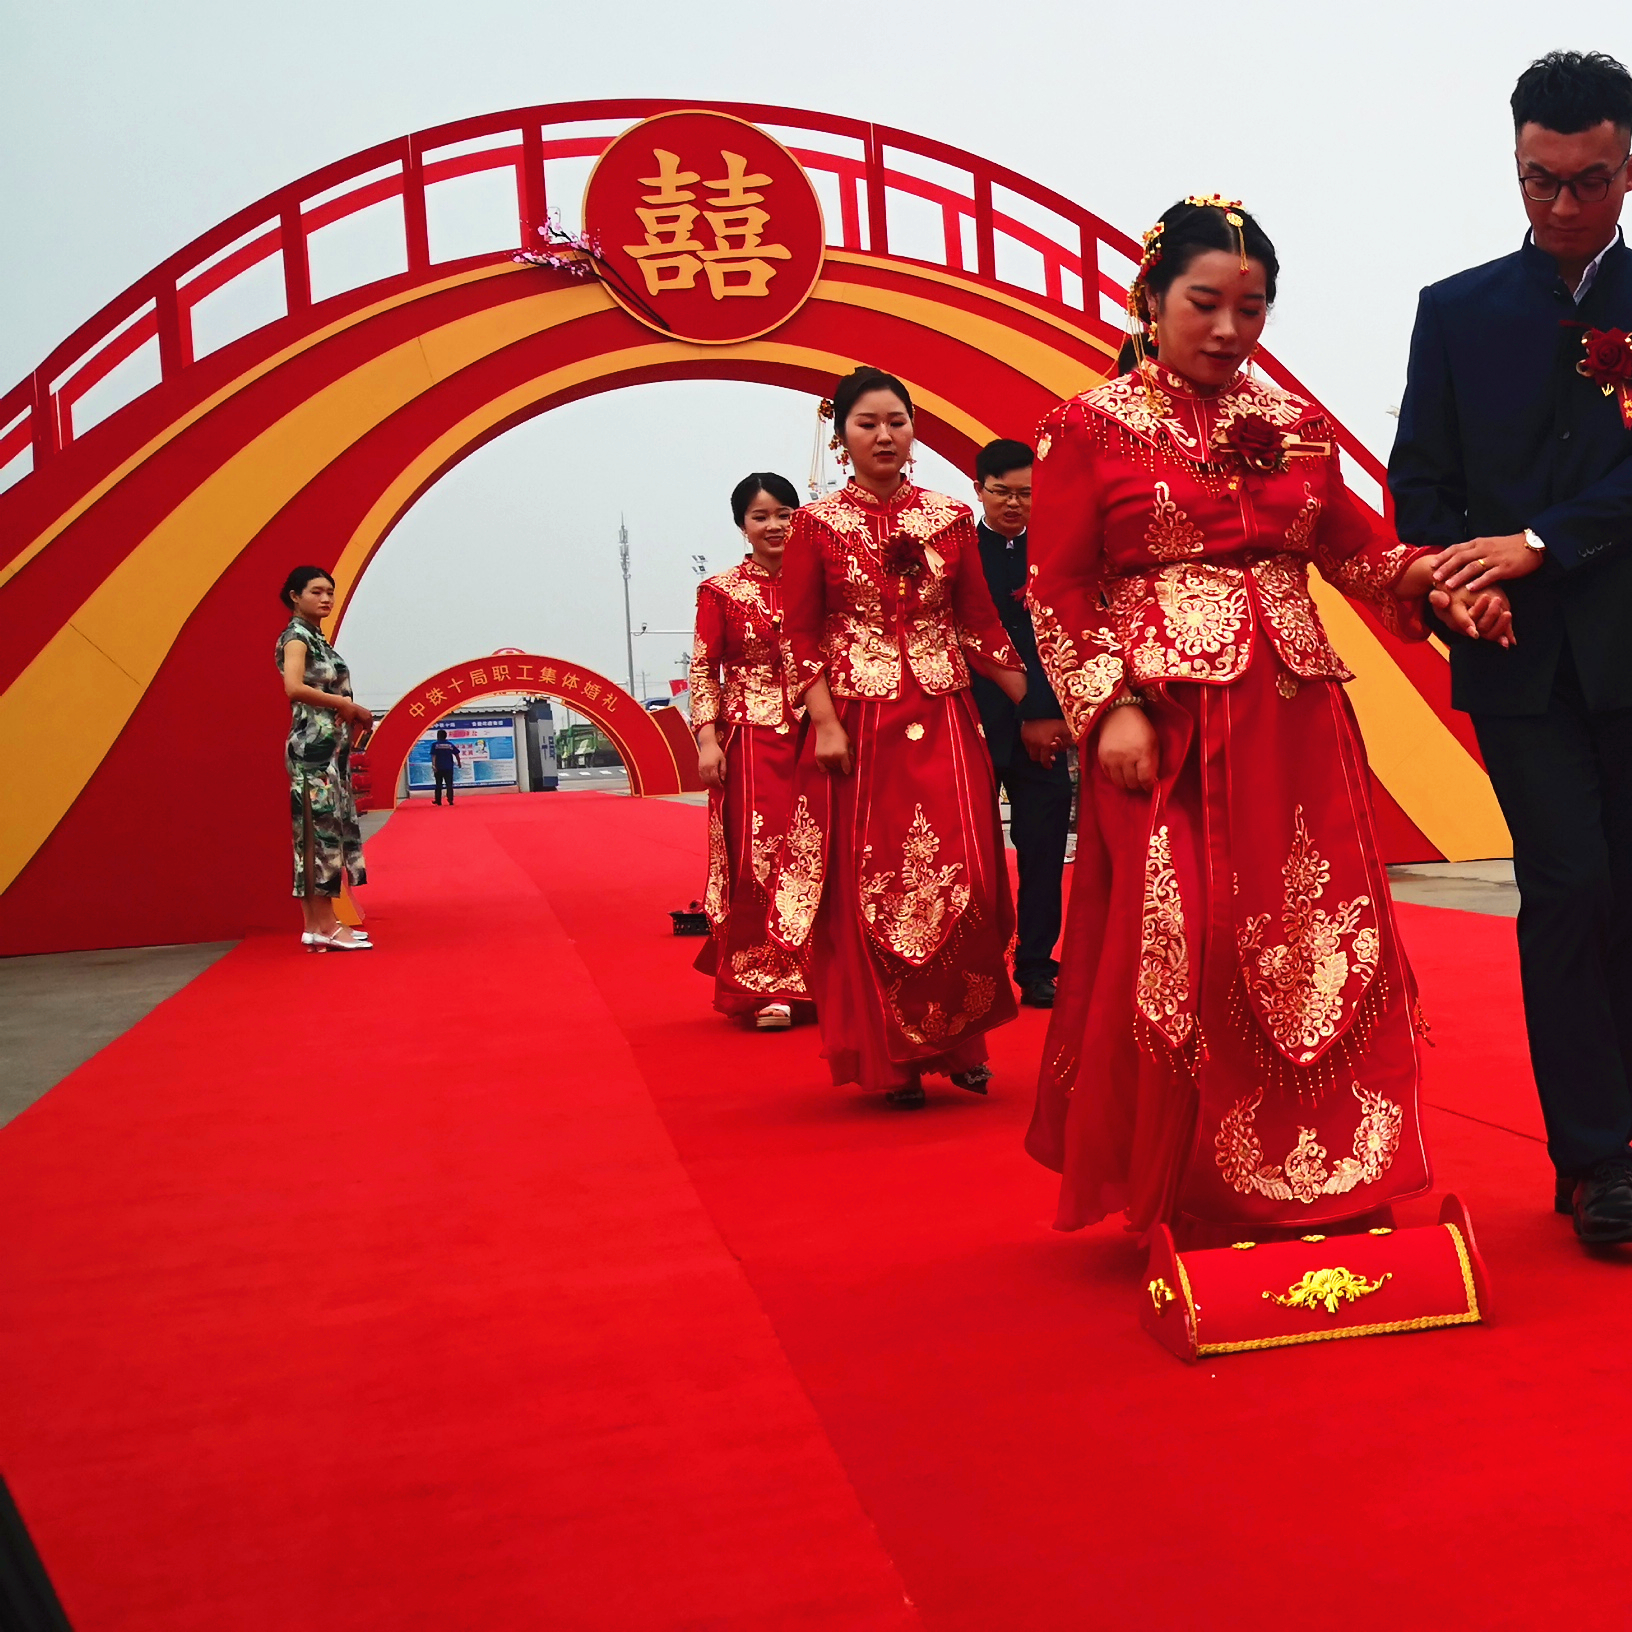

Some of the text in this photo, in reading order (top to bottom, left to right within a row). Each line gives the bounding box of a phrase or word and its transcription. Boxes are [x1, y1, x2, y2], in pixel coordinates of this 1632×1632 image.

[408, 664, 618, 719] 中铁十局职工集体婚礼
